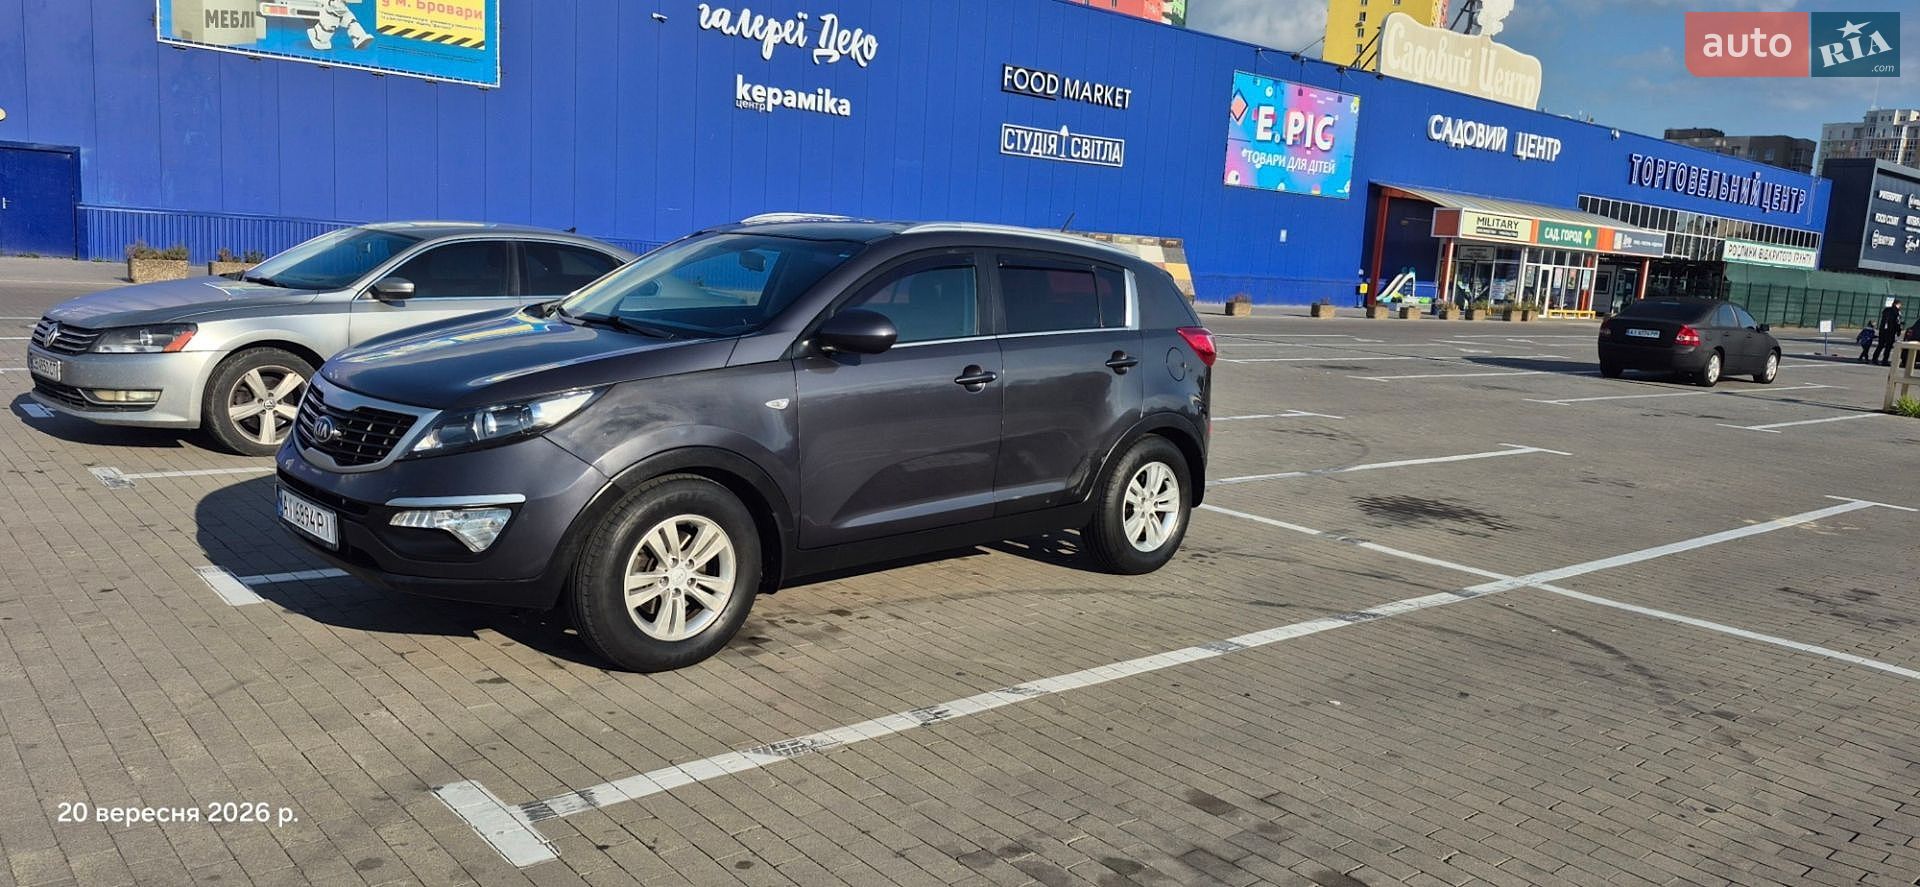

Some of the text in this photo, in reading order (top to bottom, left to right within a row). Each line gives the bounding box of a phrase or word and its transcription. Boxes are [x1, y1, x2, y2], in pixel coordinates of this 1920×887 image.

[204, 9, 255, 29] МЕБЛІ
[698, 3, 879, 67] галереї Деко
[1386, 22, 1536, 104] Садовий Центр
[735, 98, 766, 112] центр
[1003, 66, 1132, 109] FOOD MARKET
[1003, 127, 1122, 163] СТУДІЯ СВІТЛА
[1428, 114, 1562, 162] САДОВИЙ ЦЕНТР
[1286, 156, 1307, 172] ДЛЯ
[1307, 159, 1336, 175] ДІТЕЙ
[1631, 153, 1807, 214] ТОРГОВЕЛЬНИЙ ЦЕНТР
[1476, 216, 1519, 230] MILITARY
[1560, 229, 1582, 244] ГОРОД
